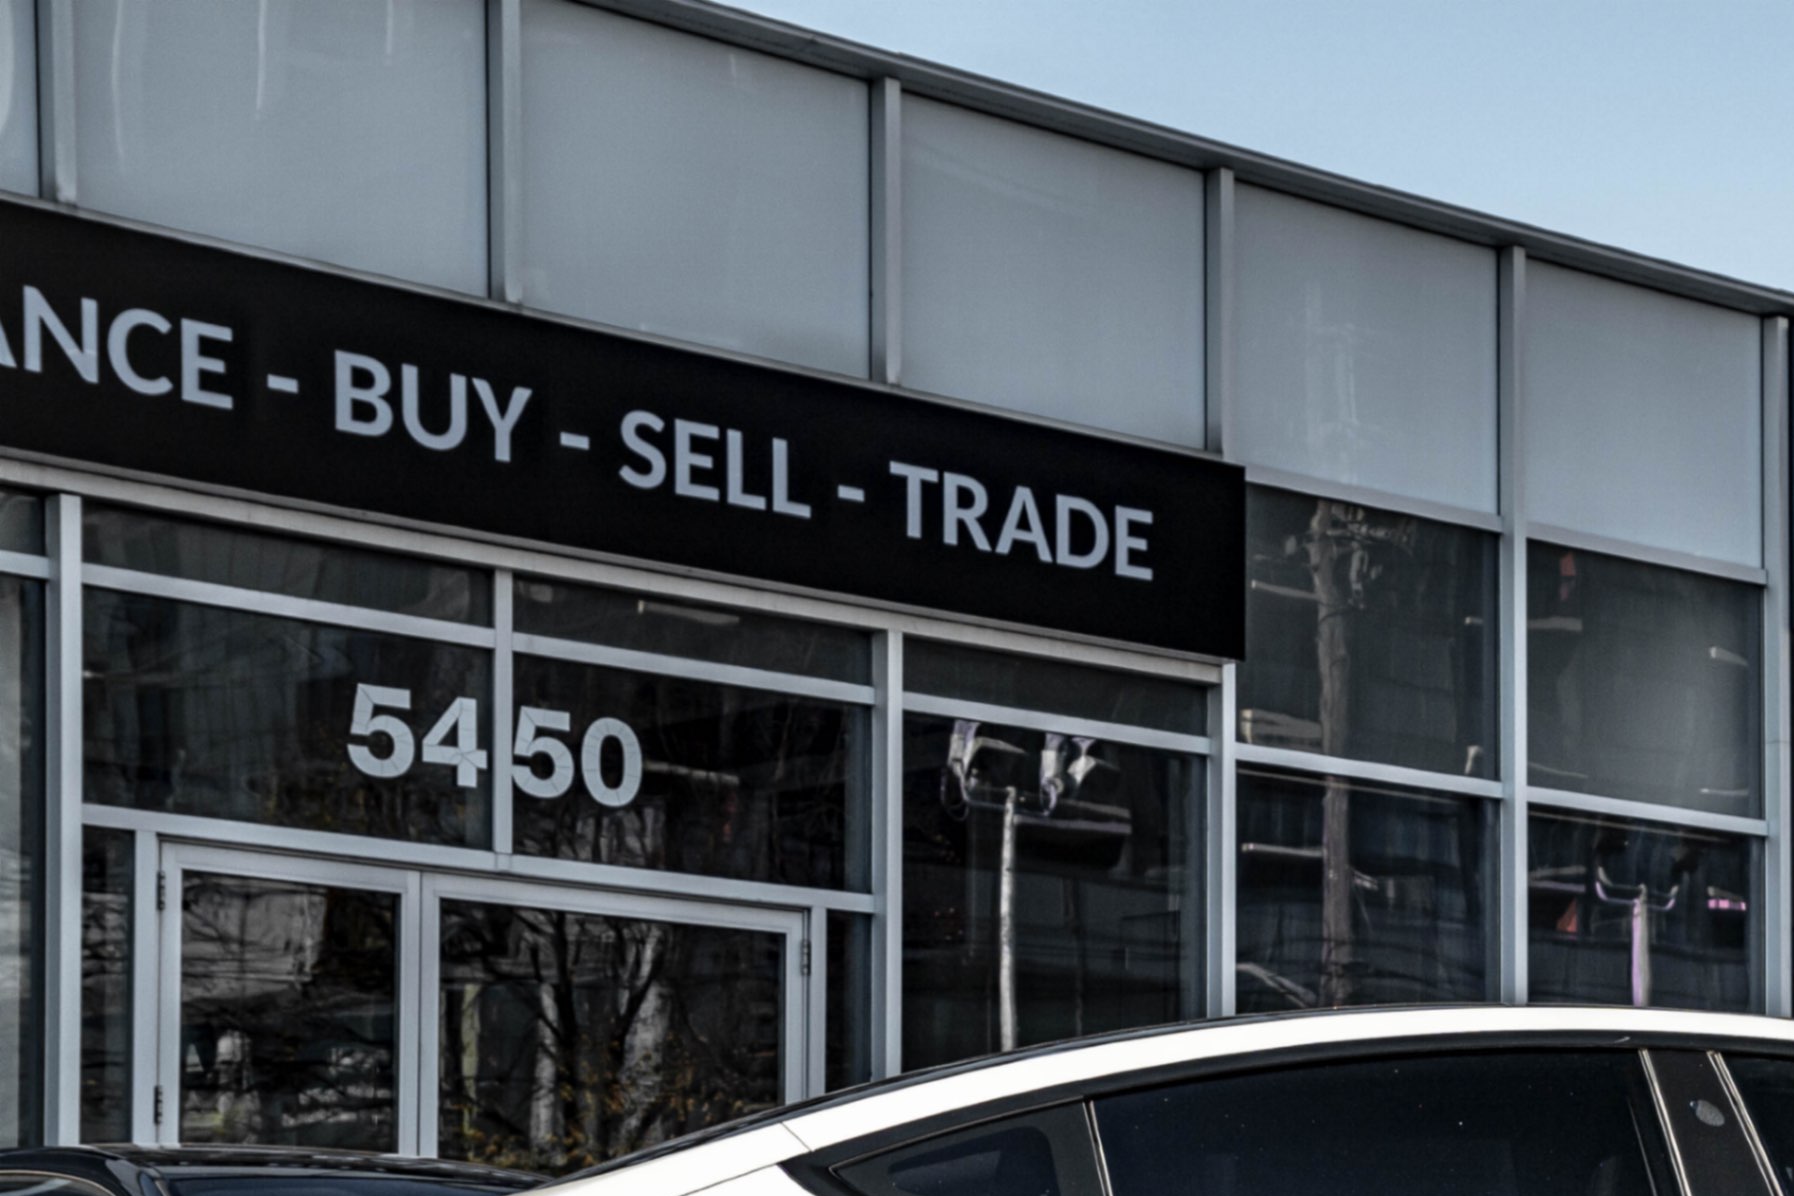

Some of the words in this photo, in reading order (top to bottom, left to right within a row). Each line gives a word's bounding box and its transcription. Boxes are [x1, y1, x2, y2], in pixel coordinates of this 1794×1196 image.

[334, 350, 532, 463] BUY
[618, 409, 811, 519] SELL
[889, 460, 1153, 581] TRADE
[347, 682, 643, 807] 5450
